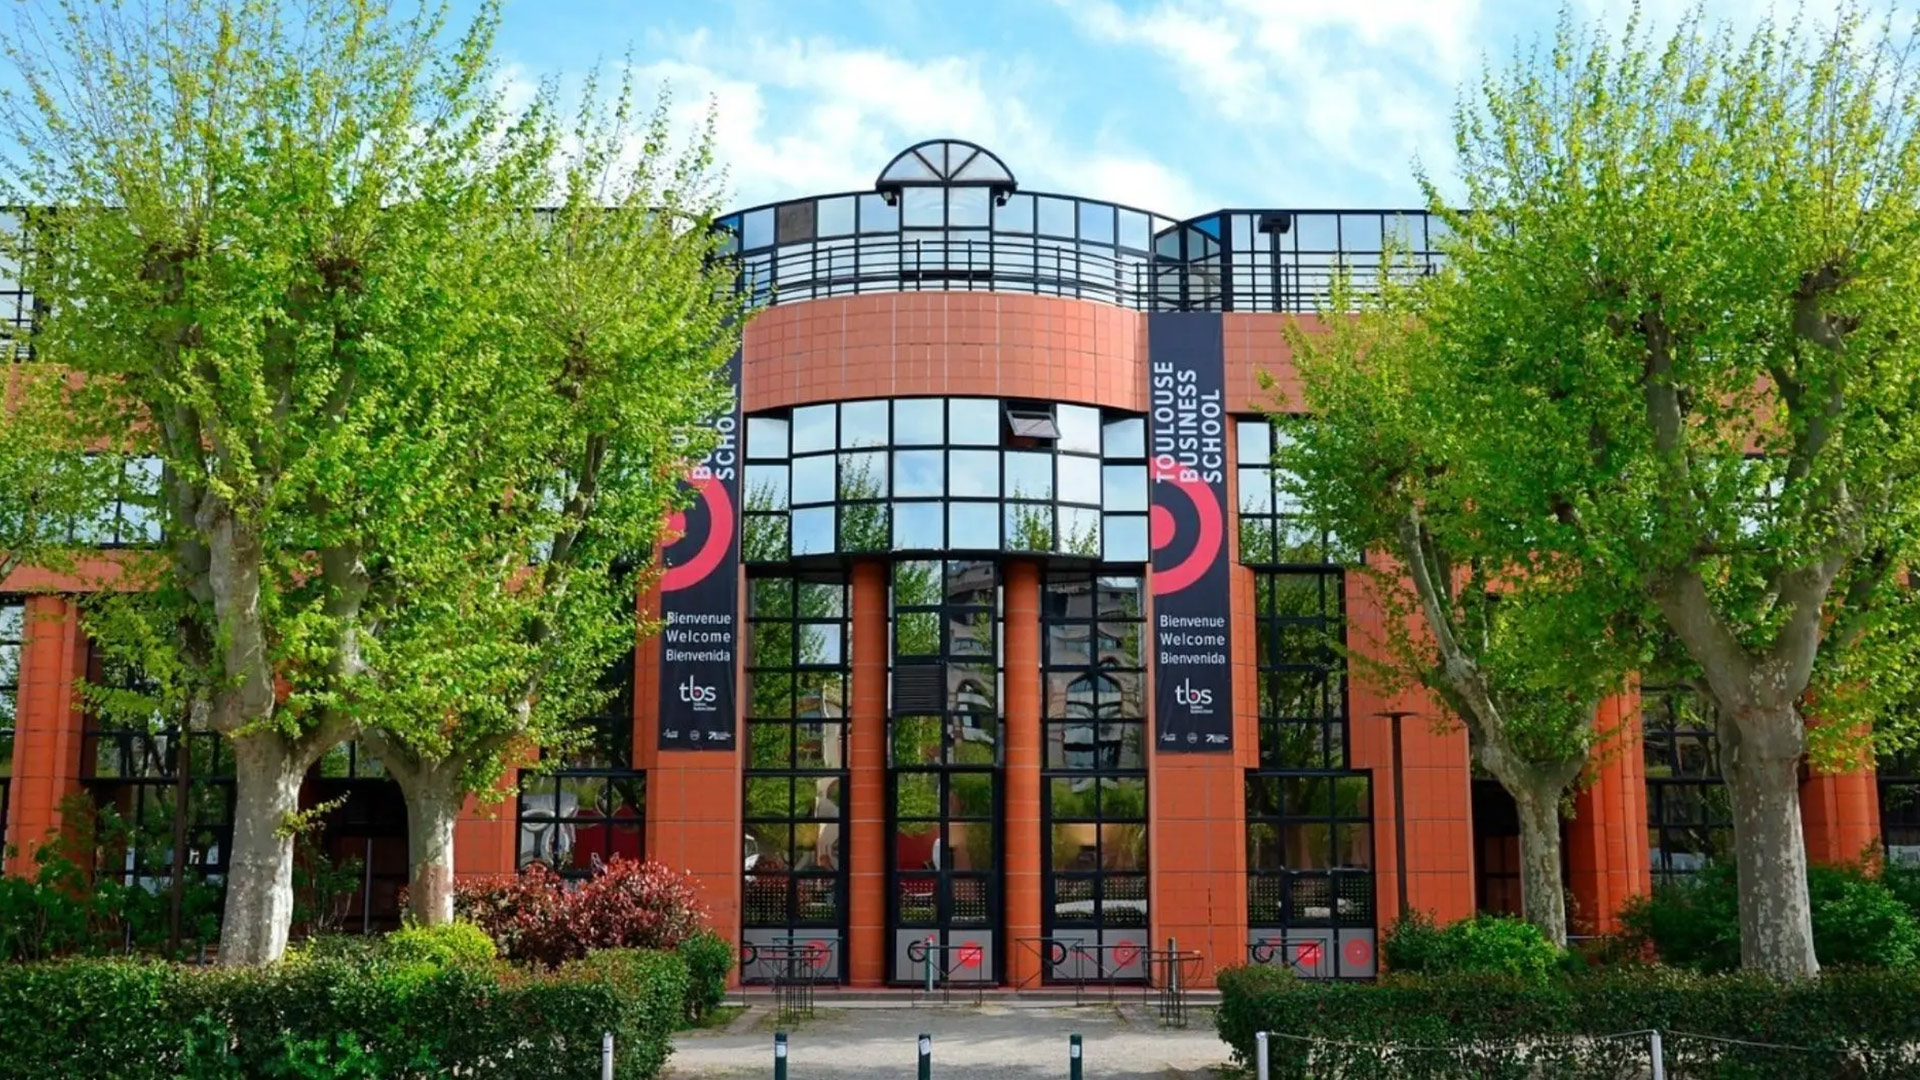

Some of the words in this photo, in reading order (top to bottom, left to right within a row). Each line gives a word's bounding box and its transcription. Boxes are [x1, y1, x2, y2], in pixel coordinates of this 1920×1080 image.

[1154, 362, 1176, 483] TOULOUSE
[1177, 369, 1199, 483] BUSINESS
[1201, 389, 1222, 484] SCHOOL
[666, 611, 732, 624] Bienvenue
[1160, 615, 1225, 628] Bienvenue
[666, 630, 731, 643] Welcome
[1160, 633, 1225, 646] Welcome
[666, 649, 731, 662] Bienvenida
[1161, 652, 1226, 664] Bienvenida
[679, 675, 717, 702] tbs
[1175, 678, 1213, 705] tbs
